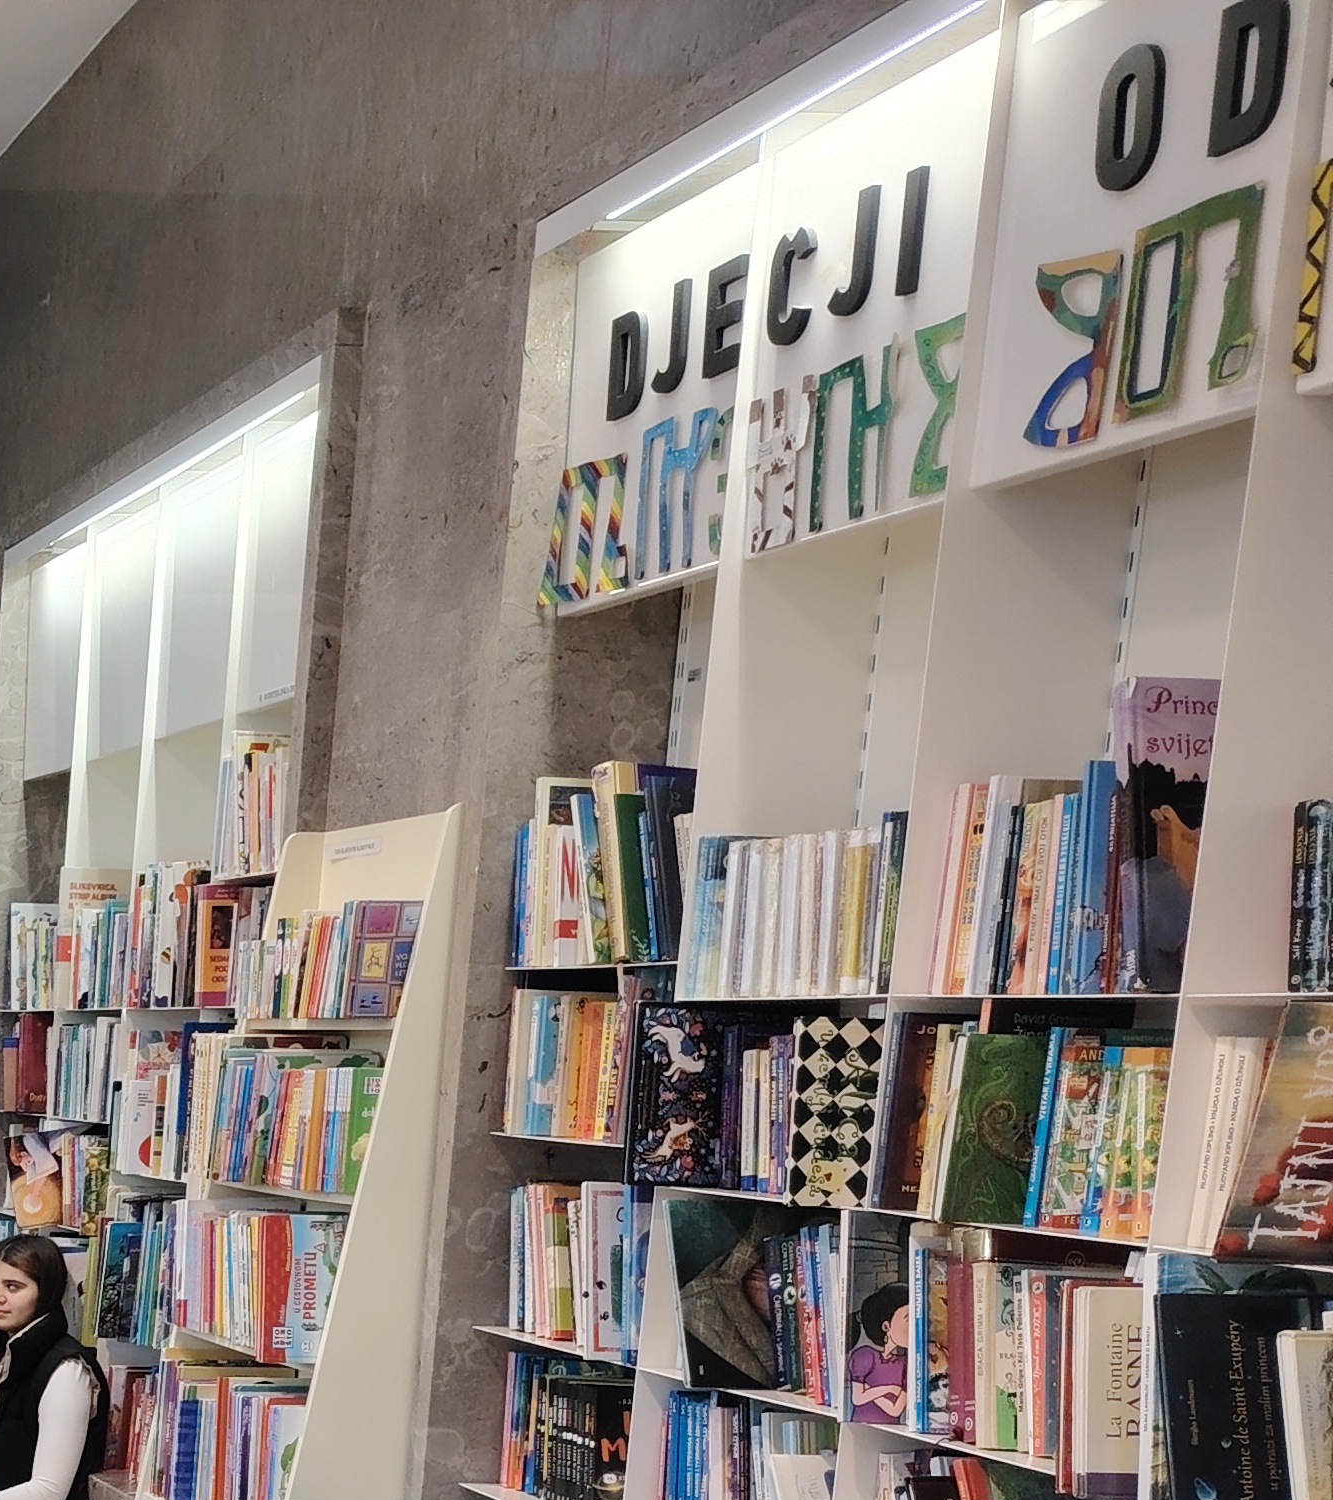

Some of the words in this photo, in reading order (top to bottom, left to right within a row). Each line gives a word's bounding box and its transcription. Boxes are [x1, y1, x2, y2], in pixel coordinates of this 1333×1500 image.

[303, 1251, 318, 1320] PROMETU
[1107, 1322, 1124, 1403] Fontaine
[1229, 1319, 1250, 1429] Saint-Exupéry
[1106, 1417, 1122, 1440] La
[1232, 1431, 1251, 1452] de
